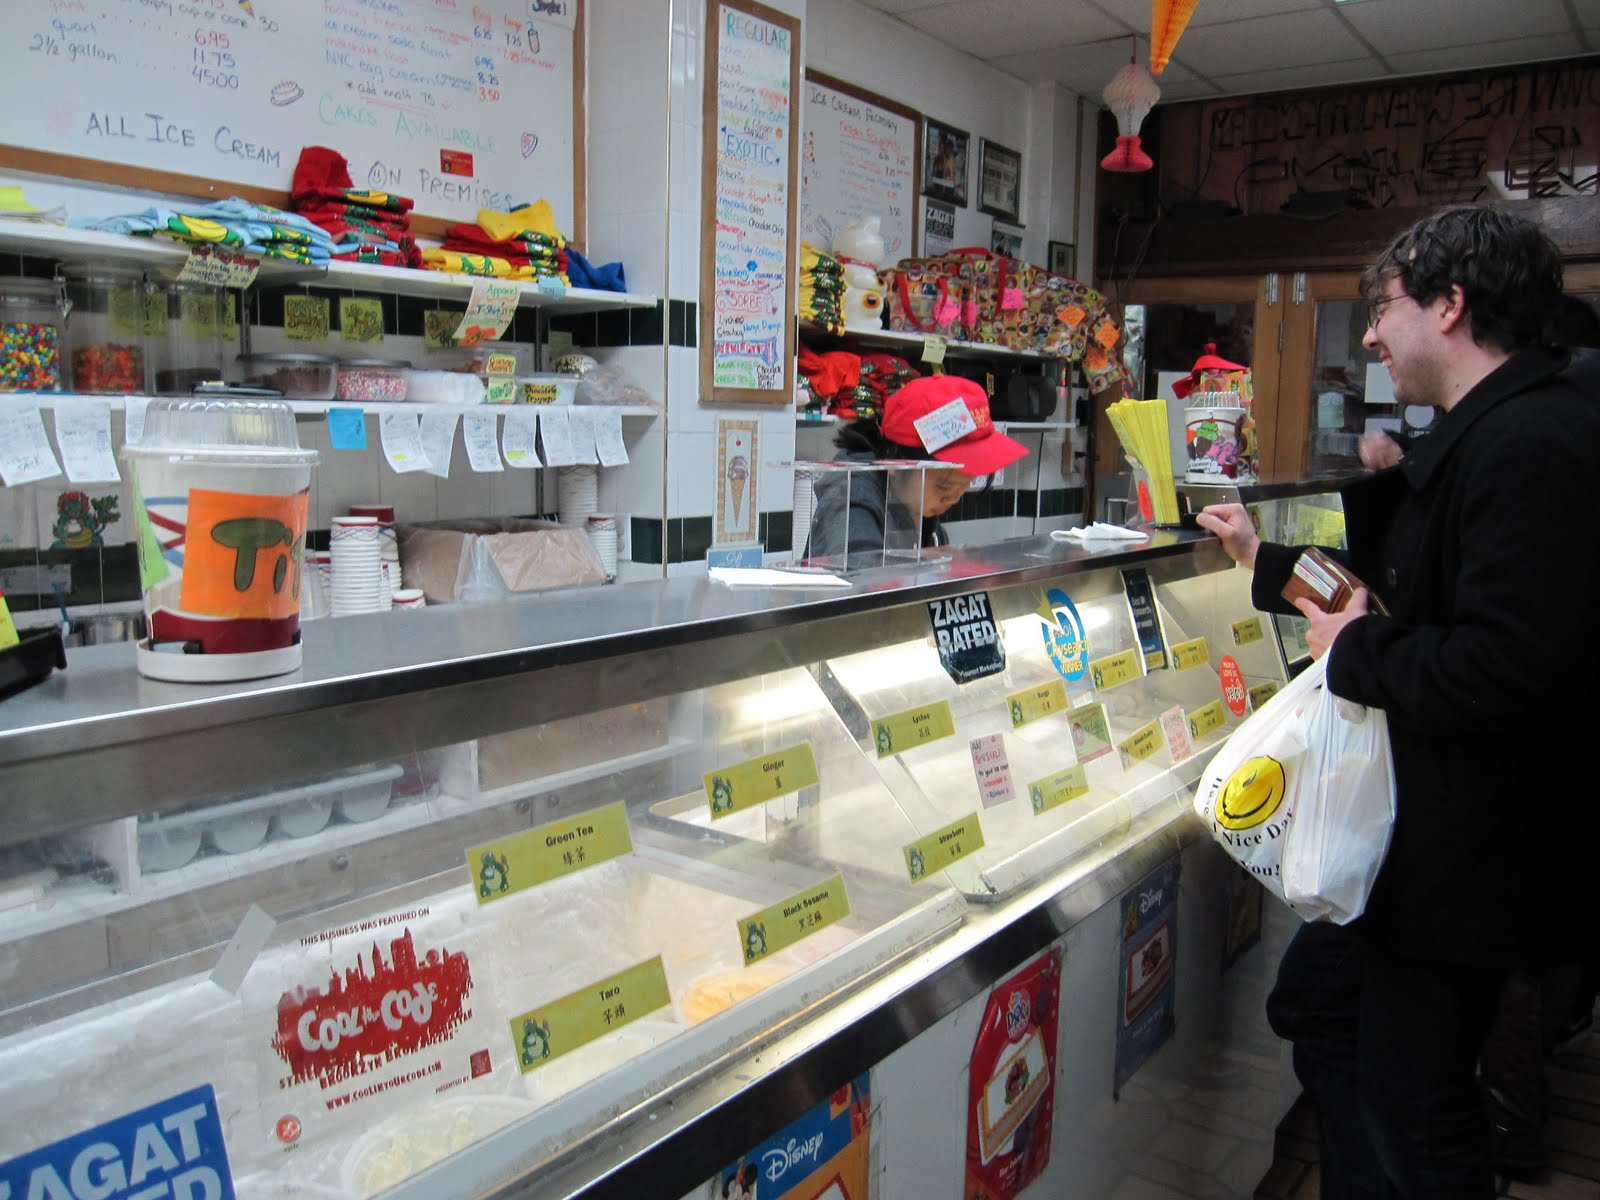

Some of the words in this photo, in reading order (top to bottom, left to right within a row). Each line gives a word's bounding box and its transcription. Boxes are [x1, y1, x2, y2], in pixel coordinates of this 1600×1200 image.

[86, 111, 136, 139] ALL
[726, 133, 776, 166] EXOTIC
[724, 551, 743, 566] Gift
[929, 592, 987, 628] ZAGAT
[936, 620, 998, 656] RATED
[1059, 658, 1085, 675] WINNER
[911, 712, 931, 725] Lychee
[762, 758, 786, 774] Ginger
[545, 829, 575, 848] Green
[575, 823, 594, 842] Tea
[938, 825, 966, 845] Strawberry
[1222, 830, 1264, 848] Nice
[782, 902, 803, 918] Black
[803, 889, 830, 909] Sesame
[299, 935, 320, 947] THIS
[319, 925, 360, 943] BUSINESS
[359, 920, 379, 933] WAS
[378, 911, 418, 928] FEATURED
[417, 907, 431, 918] ON
[598, 985, 621, 1002] Taro
[0, 1102, 208, 1200] AGAT
